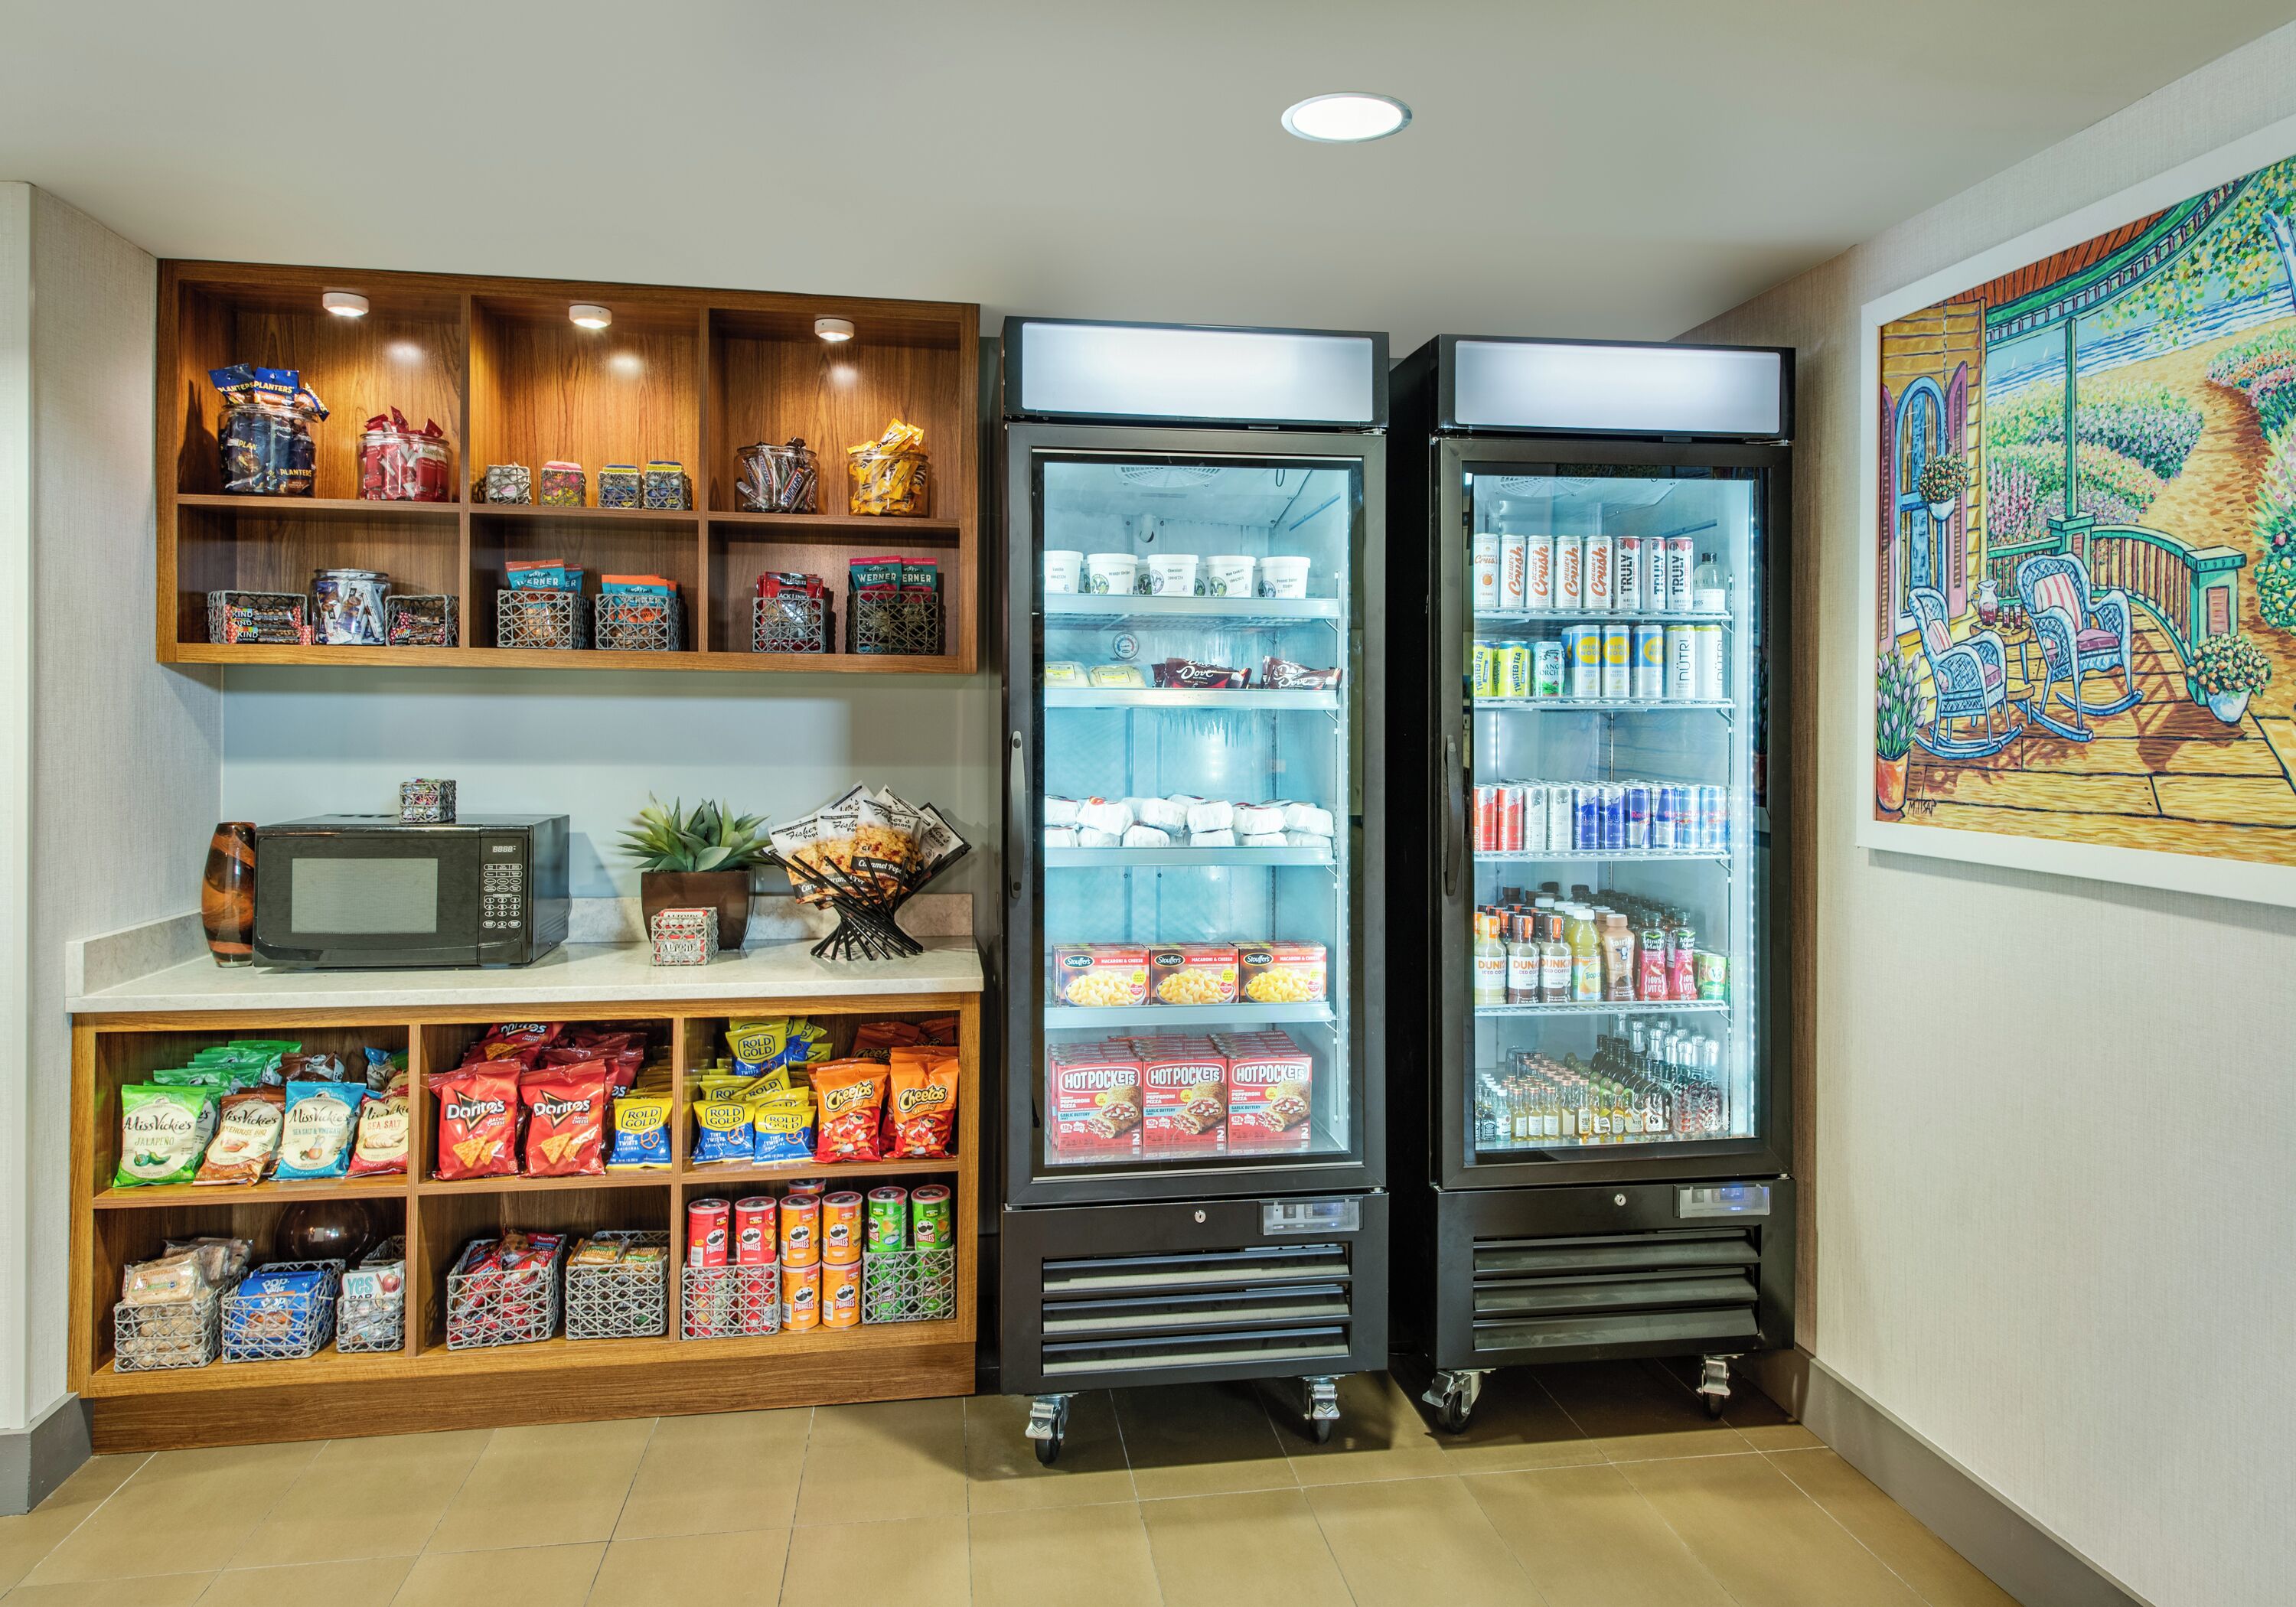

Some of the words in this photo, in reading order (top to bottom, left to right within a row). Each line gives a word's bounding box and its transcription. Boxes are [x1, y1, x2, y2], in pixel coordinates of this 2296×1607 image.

[254, 380, 293, 393] PLANTERS
[279, 468, 312, 478] PLANTERS
[782, 473, 804, 506] SNICKERS
[1508, 545, 1523, 596] Crush
[1532, 545, 1549, 596] Crush
[1564, 546, 1580, 597] Crush
[1590, 546, 1608, 597] Crush
[1620, 554, 1632, 595] TRULY
[1653, 555, 1664, 595] TRULY
[1671, 555, 1684, 595] TRULY
[517, 577, 559, 586] WERNER
[857, 573, 897, 582] WERNER
[902, 574, 931, 582] ERNER
[1513, 652, 1522, 665] TEA
[1176, 666, 1214, 680] Dove
[1475, 664, 1483, 691] TWISTED
[1512, 665, 1521, 692] TWISTED
[1067, 957, 1091, 966] Stouffer's
[1158, 956, 1182, 965] Stouffer's
[1247, 955, 1270, 964] Stouffer's
[742, 1038, 771, 1048] ROLD
[743, 1047, 772, 1057] GOLD
[1150, 1068, 1172, 1084] HOT
[1173, 1067, 1220, 1084] POCKETS
[1236, 1066, 1257, 1082] HOT
[1259, 1064, 1306, 1082] POCKETS
[1065, 1072, 1087, 1089] HOT
[1088, 1071, 1136, 1088] POCKETS
[748, 1082, 778, 1097] ROLD
[827, 1081, 873, 1111] Cheetos
[899, 1086, 947, 1111] Cheetos
[447, 1100, 505, 1120] Doritos
[533, 1100, 591, 1116] Doritos
[628, 1109, 659, 1119] ROLD
[710, 1108, 741, 1117] ROLD
[912, 1103, 937, 1115] Crunchy
[123, 1115, 154, 1131] Miss
[153, 1112, 191, 1134] Vickie's
[243, 1108, 278, 1127] Vickie's
[289, 1109, 313, 1124] Miss
[625, 1118, 657, 1127] GOLD
[709, 1116, 741, 1125] GOLD
[367, 1121, 381, 1130] SEA
[384, 1120, 403, 1129] SALT
[1218, 1129, 1225, 1138] 2
[134, 1136, 174, 1146] JALAPEÑO
[790, 1240, 810, 1250] PRINGLES
[829, 1237, 849, 1247] PRINGLES
[918, 1234, 935, 1243] PRINGLES
[706, 1241, 725, 1255] PRINGLES
[742, 1241, 761, 1252] PRINGLES
[794, 1301, 814, 1312] PRINGLES
[836, 1298, 855, 1310] PRINGLES
